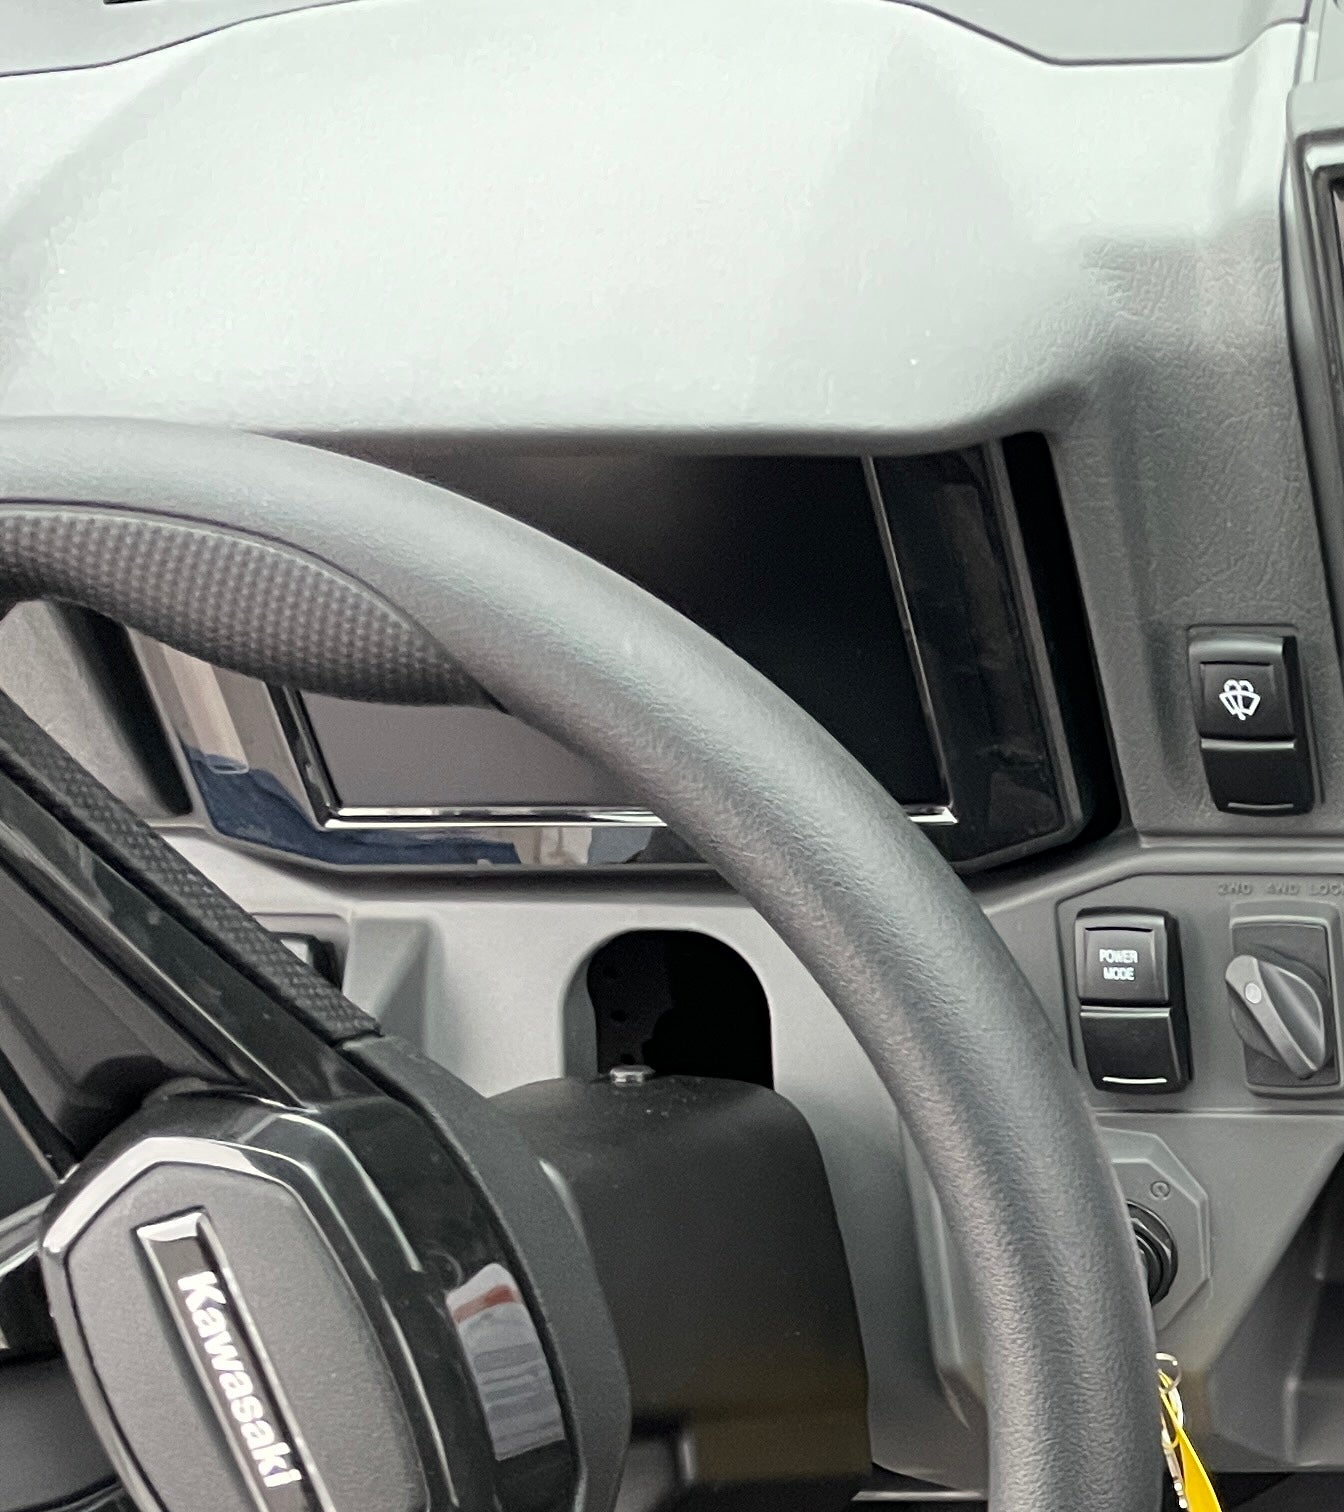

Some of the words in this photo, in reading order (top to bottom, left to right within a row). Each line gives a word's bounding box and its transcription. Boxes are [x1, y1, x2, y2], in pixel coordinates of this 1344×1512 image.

[1099, 949, 1138, 963] POWER
[1103, 966, 1135, 981] MODE
[177, 1269, 303, 1487] Kawasaki
